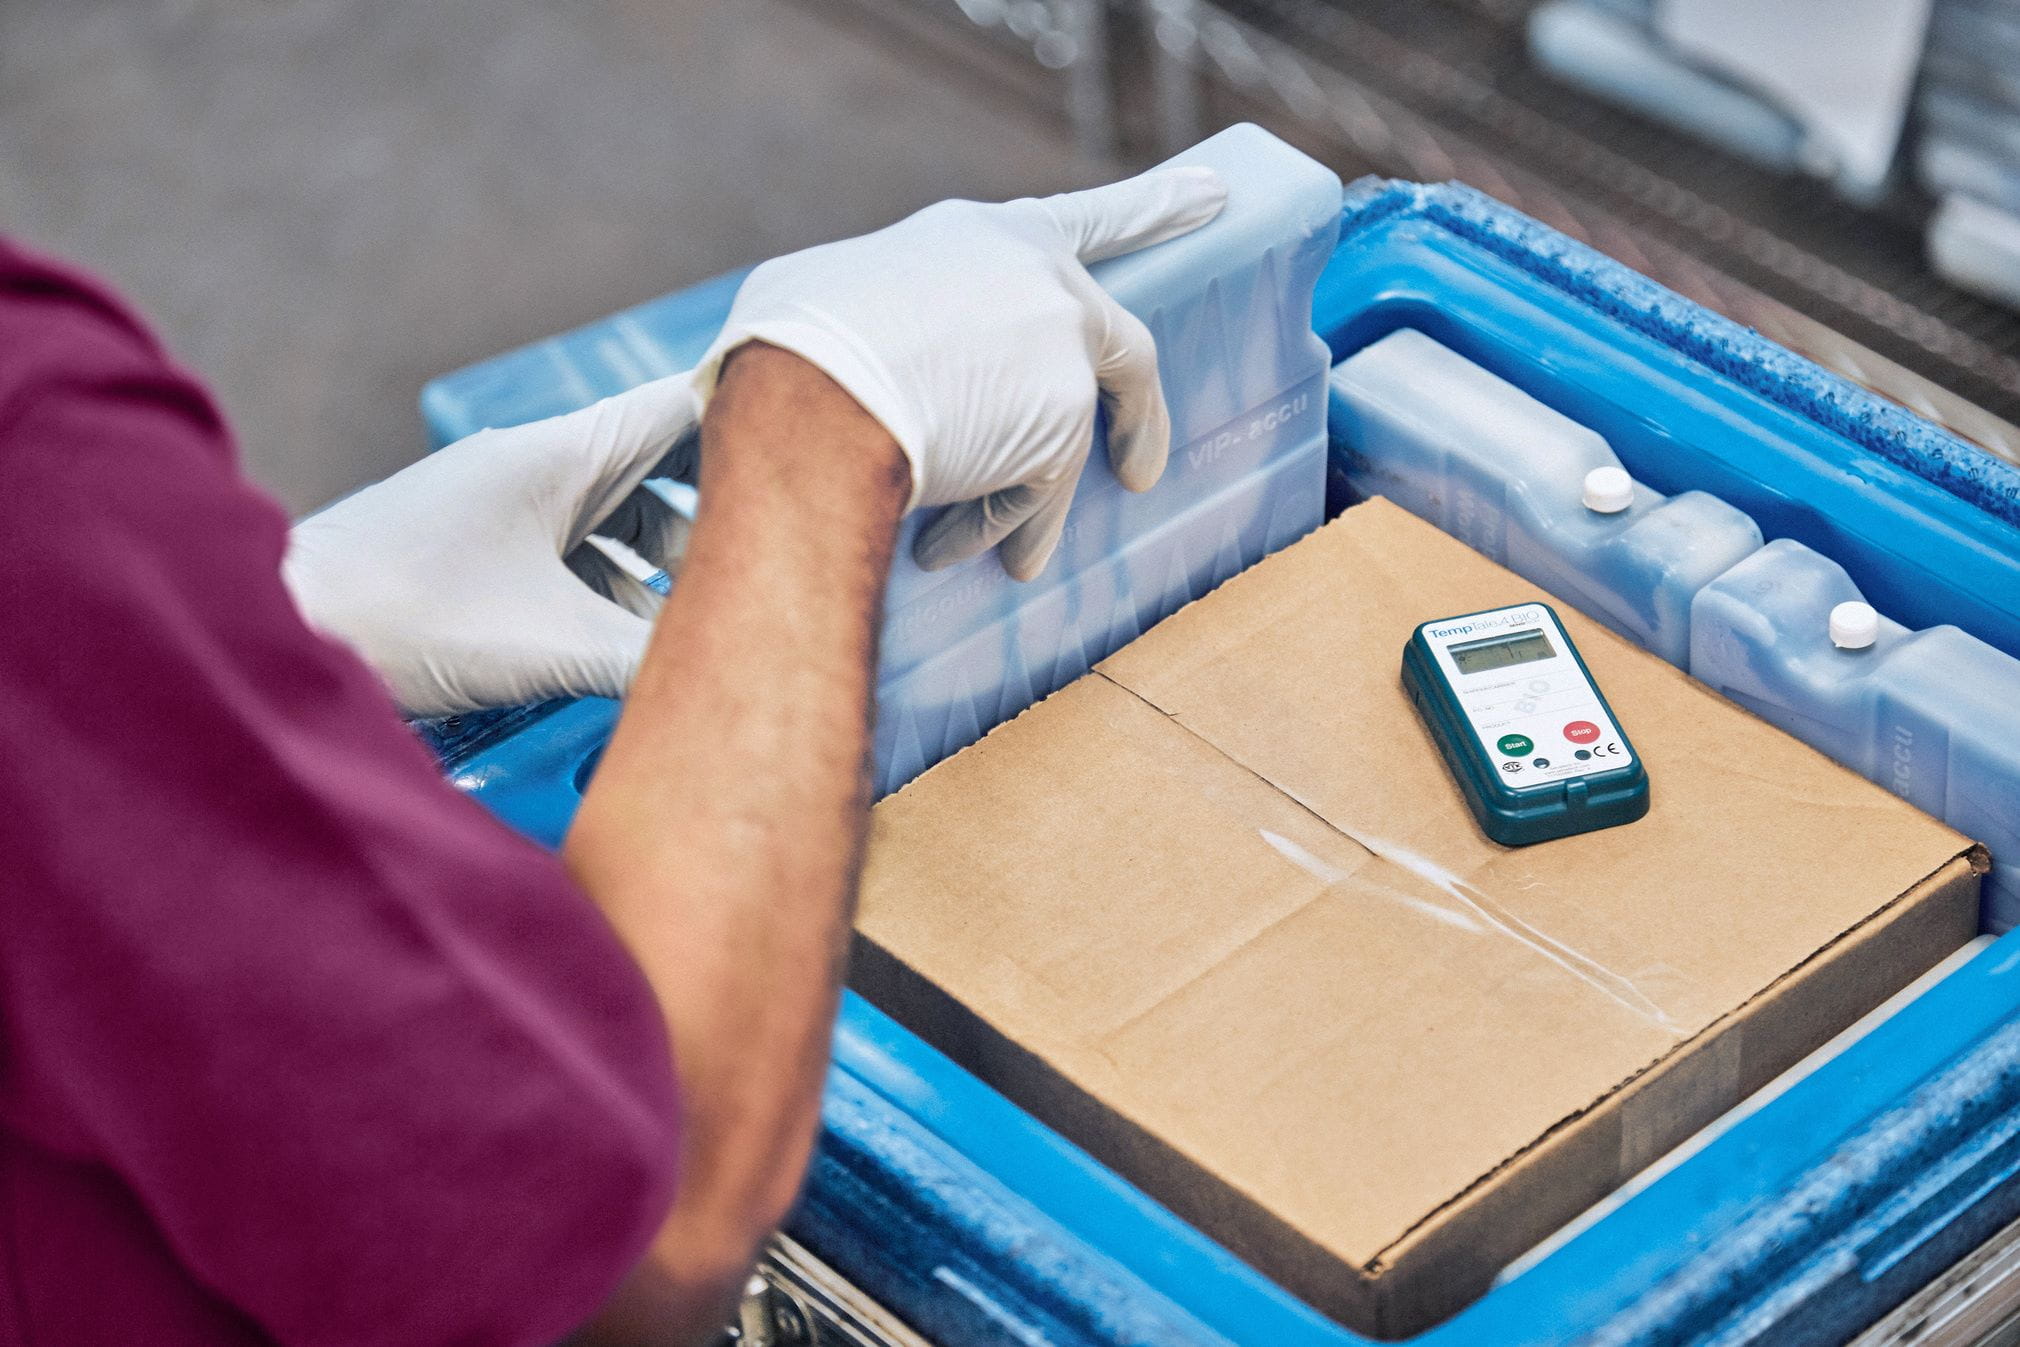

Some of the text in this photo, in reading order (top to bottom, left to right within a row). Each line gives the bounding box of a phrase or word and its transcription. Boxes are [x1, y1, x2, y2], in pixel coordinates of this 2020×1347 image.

[1188, 393, 1308, 470] VIP- accu
[1570, 727, 1592, 737] Stop
[1504, 740, 1527, 750] Start
